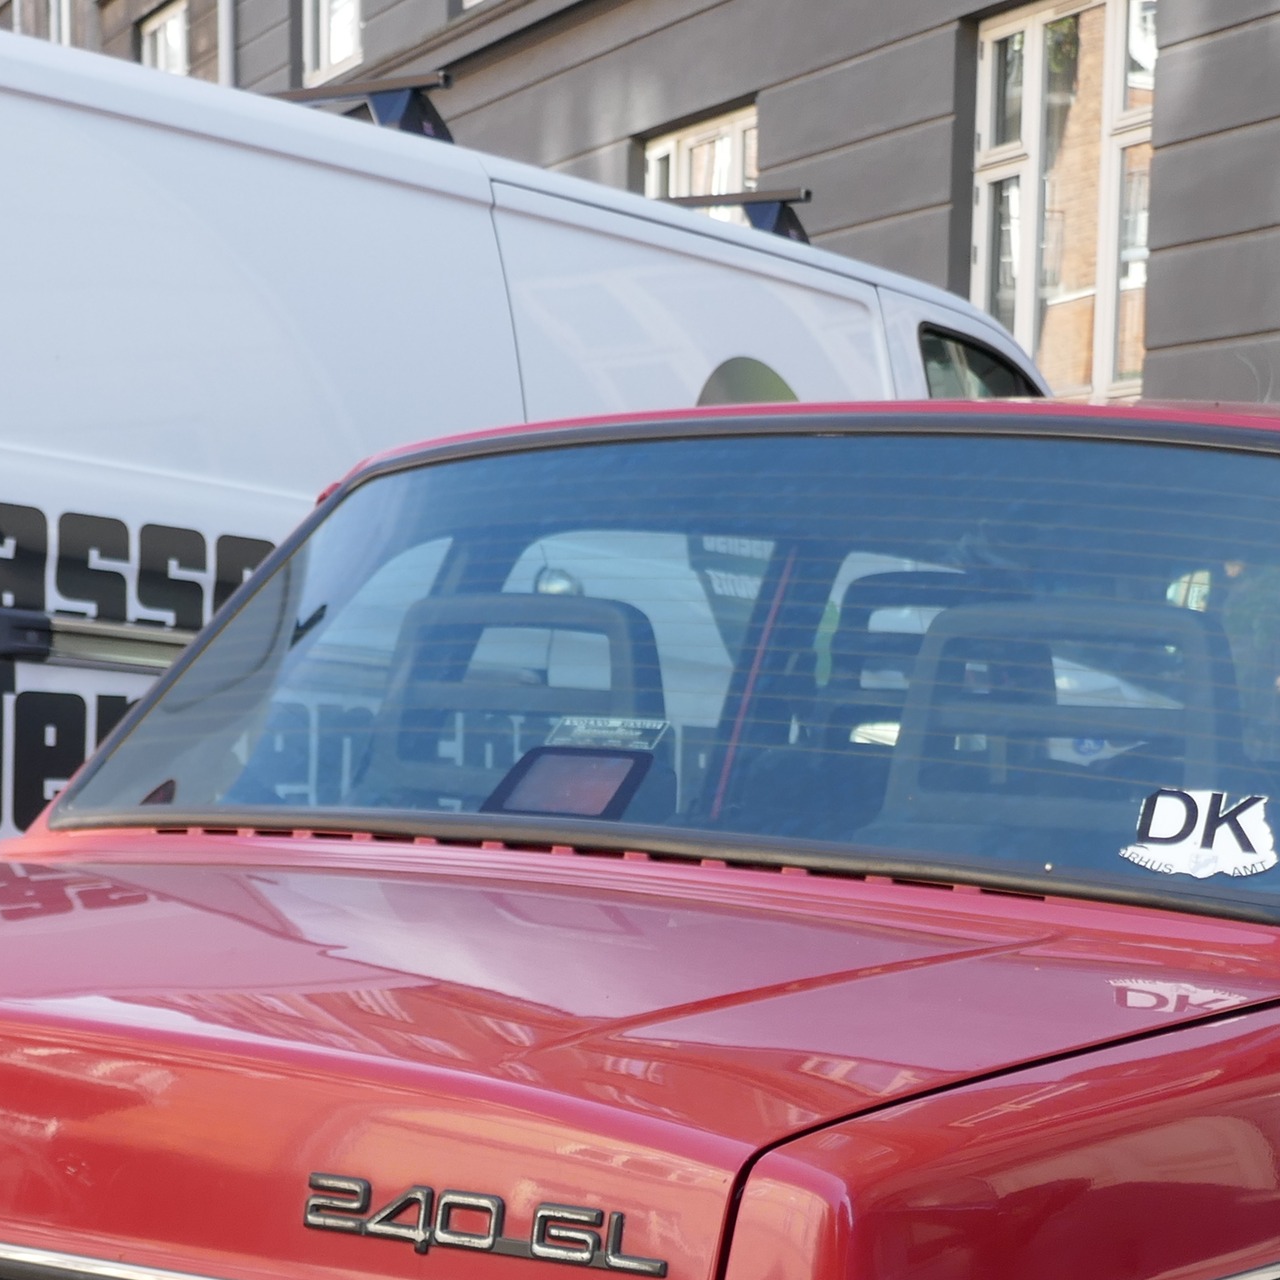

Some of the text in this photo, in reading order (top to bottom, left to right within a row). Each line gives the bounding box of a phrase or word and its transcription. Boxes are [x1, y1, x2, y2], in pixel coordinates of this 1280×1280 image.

[1136, 788, 1268, 854] DK
[1231, 860, 1267, 877] AMT
[303, 1172, 668, 1278] 240 GL
